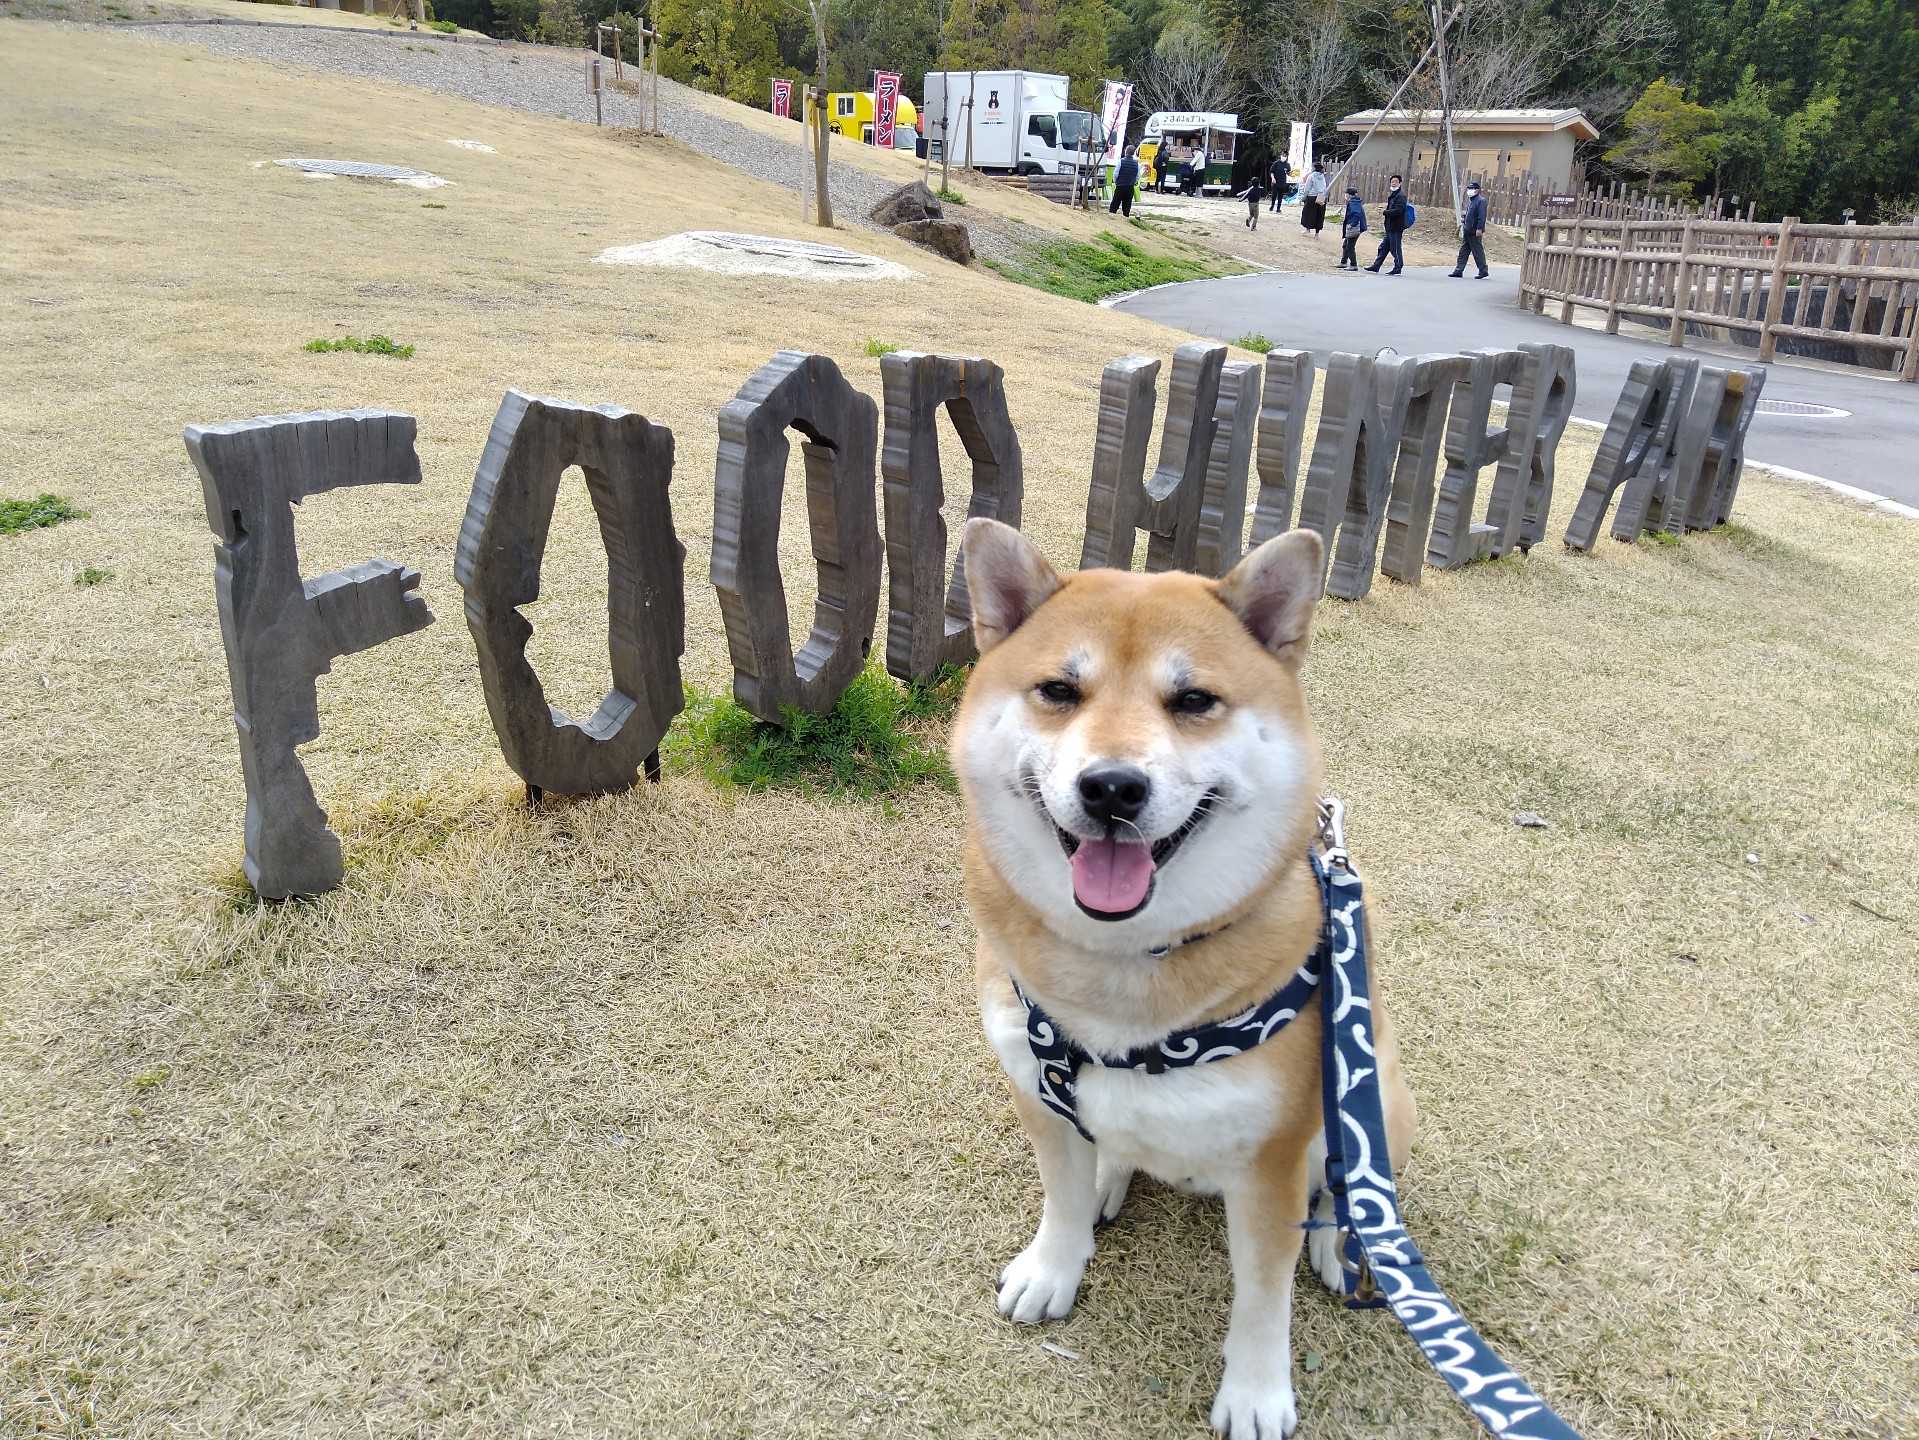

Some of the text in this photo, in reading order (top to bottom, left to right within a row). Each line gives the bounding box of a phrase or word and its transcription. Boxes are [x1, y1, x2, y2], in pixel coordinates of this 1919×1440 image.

[879, 80, 895, 143] ラーメン
[184, 349, 1023, 899] FOOD
